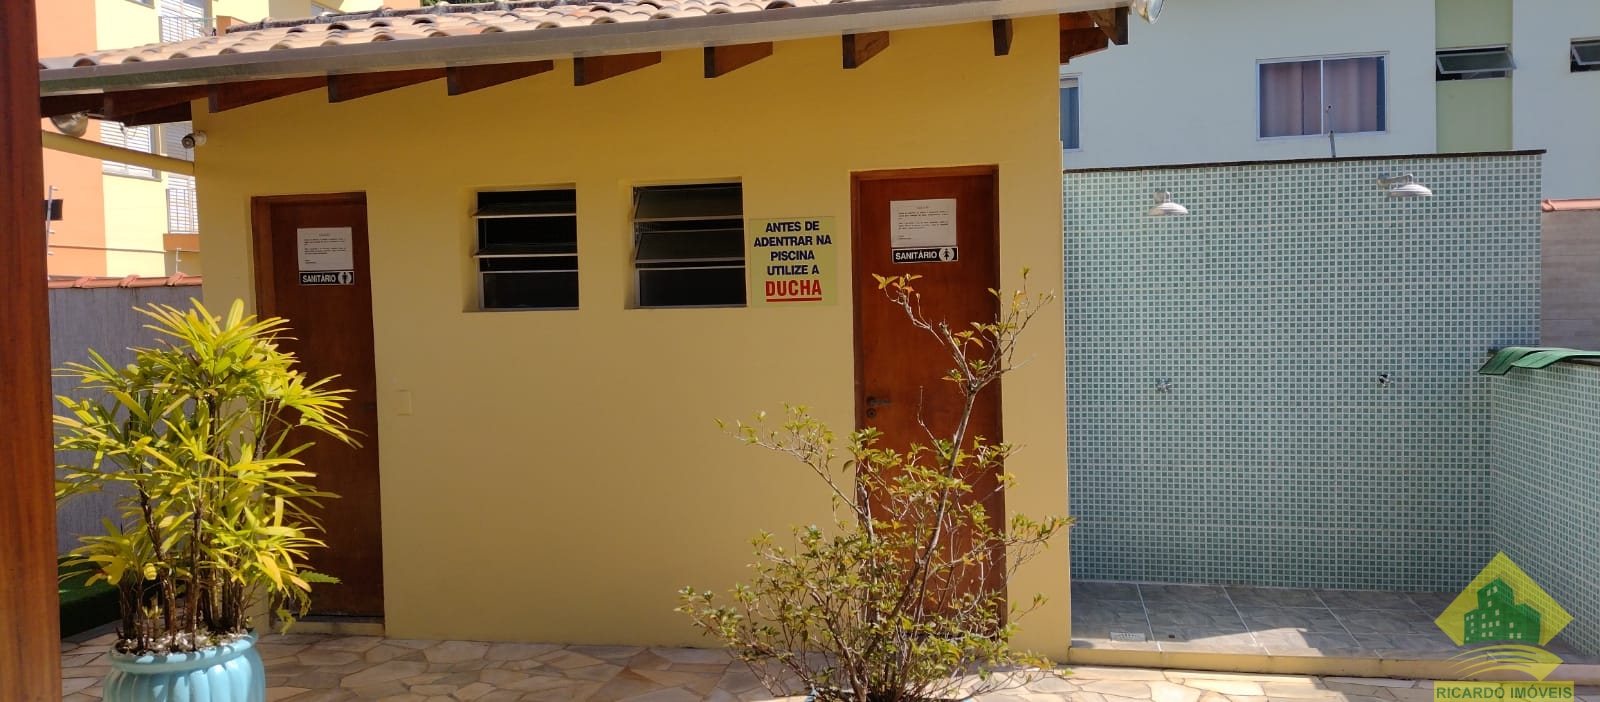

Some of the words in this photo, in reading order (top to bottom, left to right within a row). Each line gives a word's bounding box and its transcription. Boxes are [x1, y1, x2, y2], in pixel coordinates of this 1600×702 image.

[765, 221, 801, 233] ANTES
[805, 220, 820, 231] DE
[753, 236, 813, 247] ADENTRAR
[816, 234, 832, 245] NA
[770, 250, 815, 261] PISCINA
[895, 250, 937, 260] SANITÁRIO
[767, 265, 809, 276] UTILIZE
[811, 264, 820, 275] A
[765, 279, 822, 297] DUCHA
